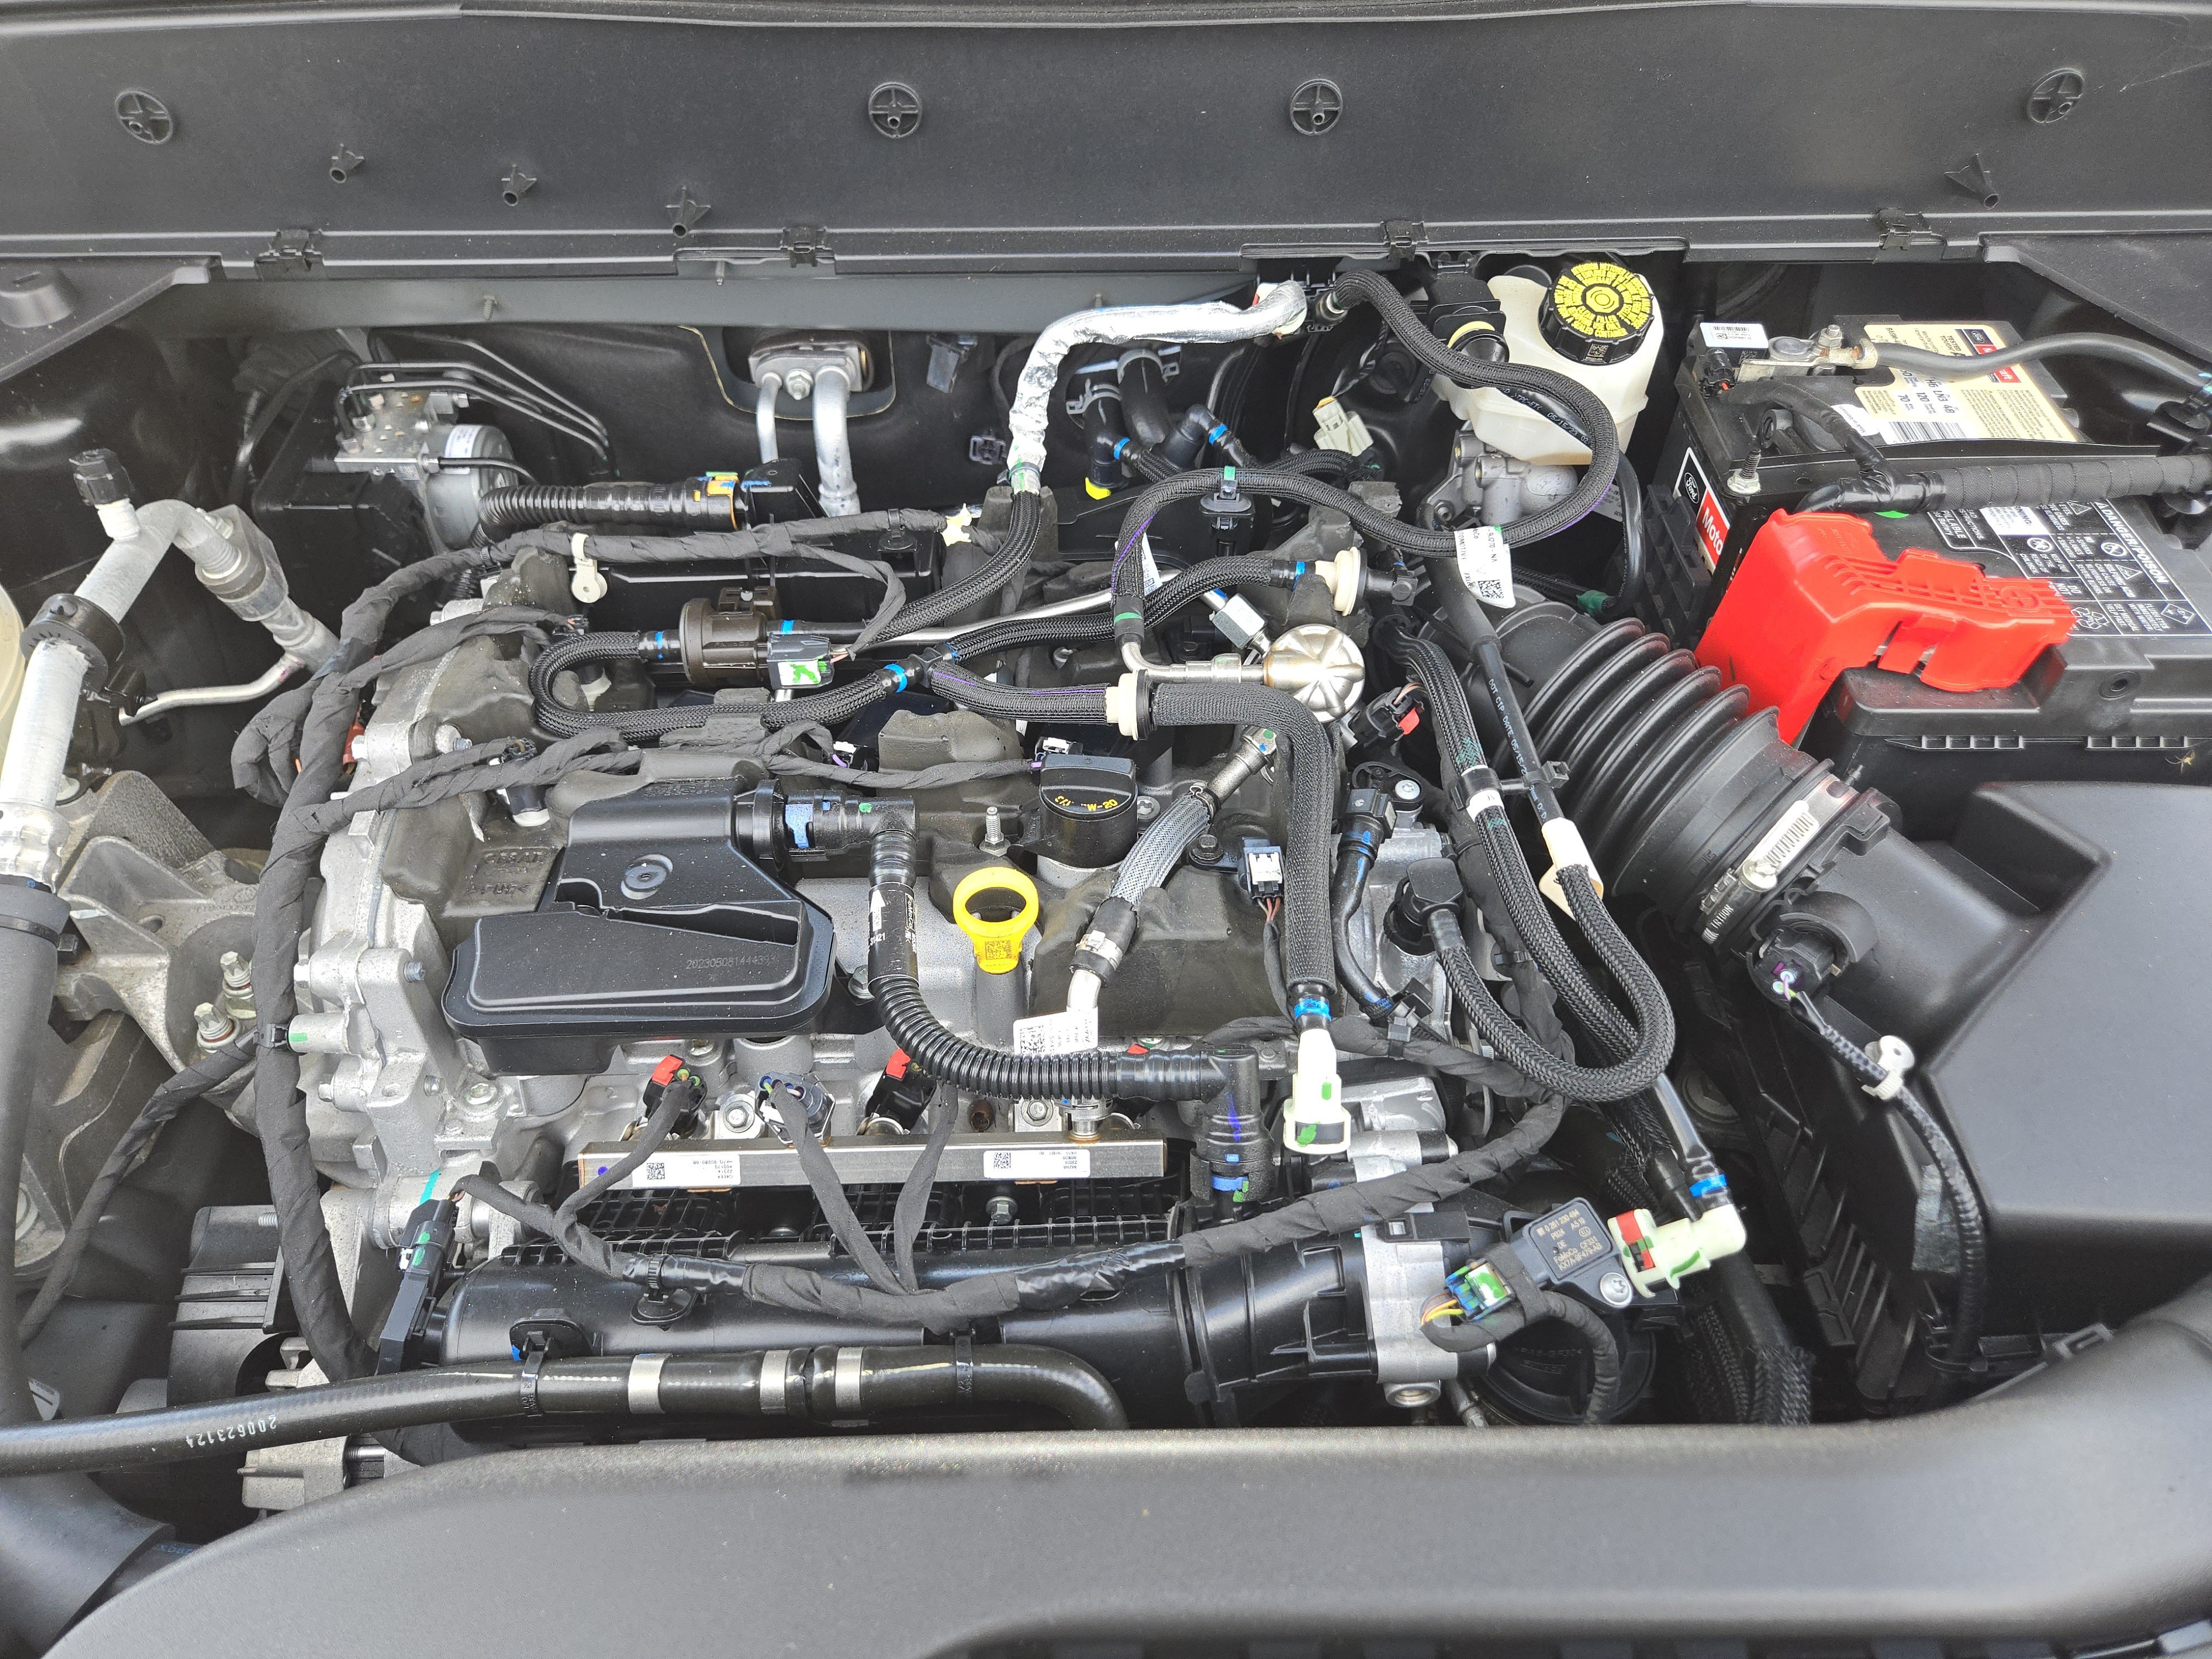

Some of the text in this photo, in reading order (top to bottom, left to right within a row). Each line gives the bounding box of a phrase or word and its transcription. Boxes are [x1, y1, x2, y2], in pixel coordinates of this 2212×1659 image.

[1945, 335, 1961, 351] TESTED
[1916, 392, 1930, 401] 120
[1932, 390, 1948, 401] LN3
[1942, 404, 1955, 413] 48
[1547, 412, 1577, 436] 05/15/23
[1686, 476, 1697, 500] Ford
[2053, 512, 2070, 525] GASES
[2058, 504, 2074, 515] EYES.
[1934, 518, 1955, 535] Battery
[2043, 510, 2065, 530] BLINDNESS
[2057, 539, 2077, 557] SMOKING
[2066, 539, 2084, 555] FLAMES
[2075, 539, 2093, 554] SPARKS
[2100, 509, 2169, 582] DANGER/POISON
[2018, 553, 2040, 574] CHILDREN.
[2029, 554, 2044, 566] REACH
[2049, 554, 2063, 563] KEEP
[2074, 564, 2105, 595] SEVERE BURNS.
[2084, 564, 2107, 586] BLINDNESS
[2093, 563, 2116, 586] CAN CAUSE
[2103, 564, 2136, 597] SULFURIC ACID
[2054, 583, 2072, 595] NOT
[2066, 585, 2082, 594] DO
[2104, 603, 2128, 627] HELP FAST.
[2112, 603, 2140, 631] GET MEDICAL
[2127, 603, 2154, 631] WITH WATER.
[2135, 603, 2163, 631] IMMEDIATELY
[2143, 603, 2169, 628] FLUSH EYES
[1486, 678, 1498, 693] DOT
[1493, 696, 1506, 712] CIP
[1500, 715, 1515, 737] DATE
[1527, 784, 1538, 801] 9mm
[1710, 904, 1734, 930] TRIDON
[1543, 1224, 1551, 1232] 0
[1547, 1219, 1560, 1230] 261
[1567, 1208, 1580, 1219] 494
[1556, 1239, 1568, 1249] DE
[1552, 1245, 1579, 1264] FoMoCo
[1557, 1241, 1603, 1271] KX7A-9F479-AB
